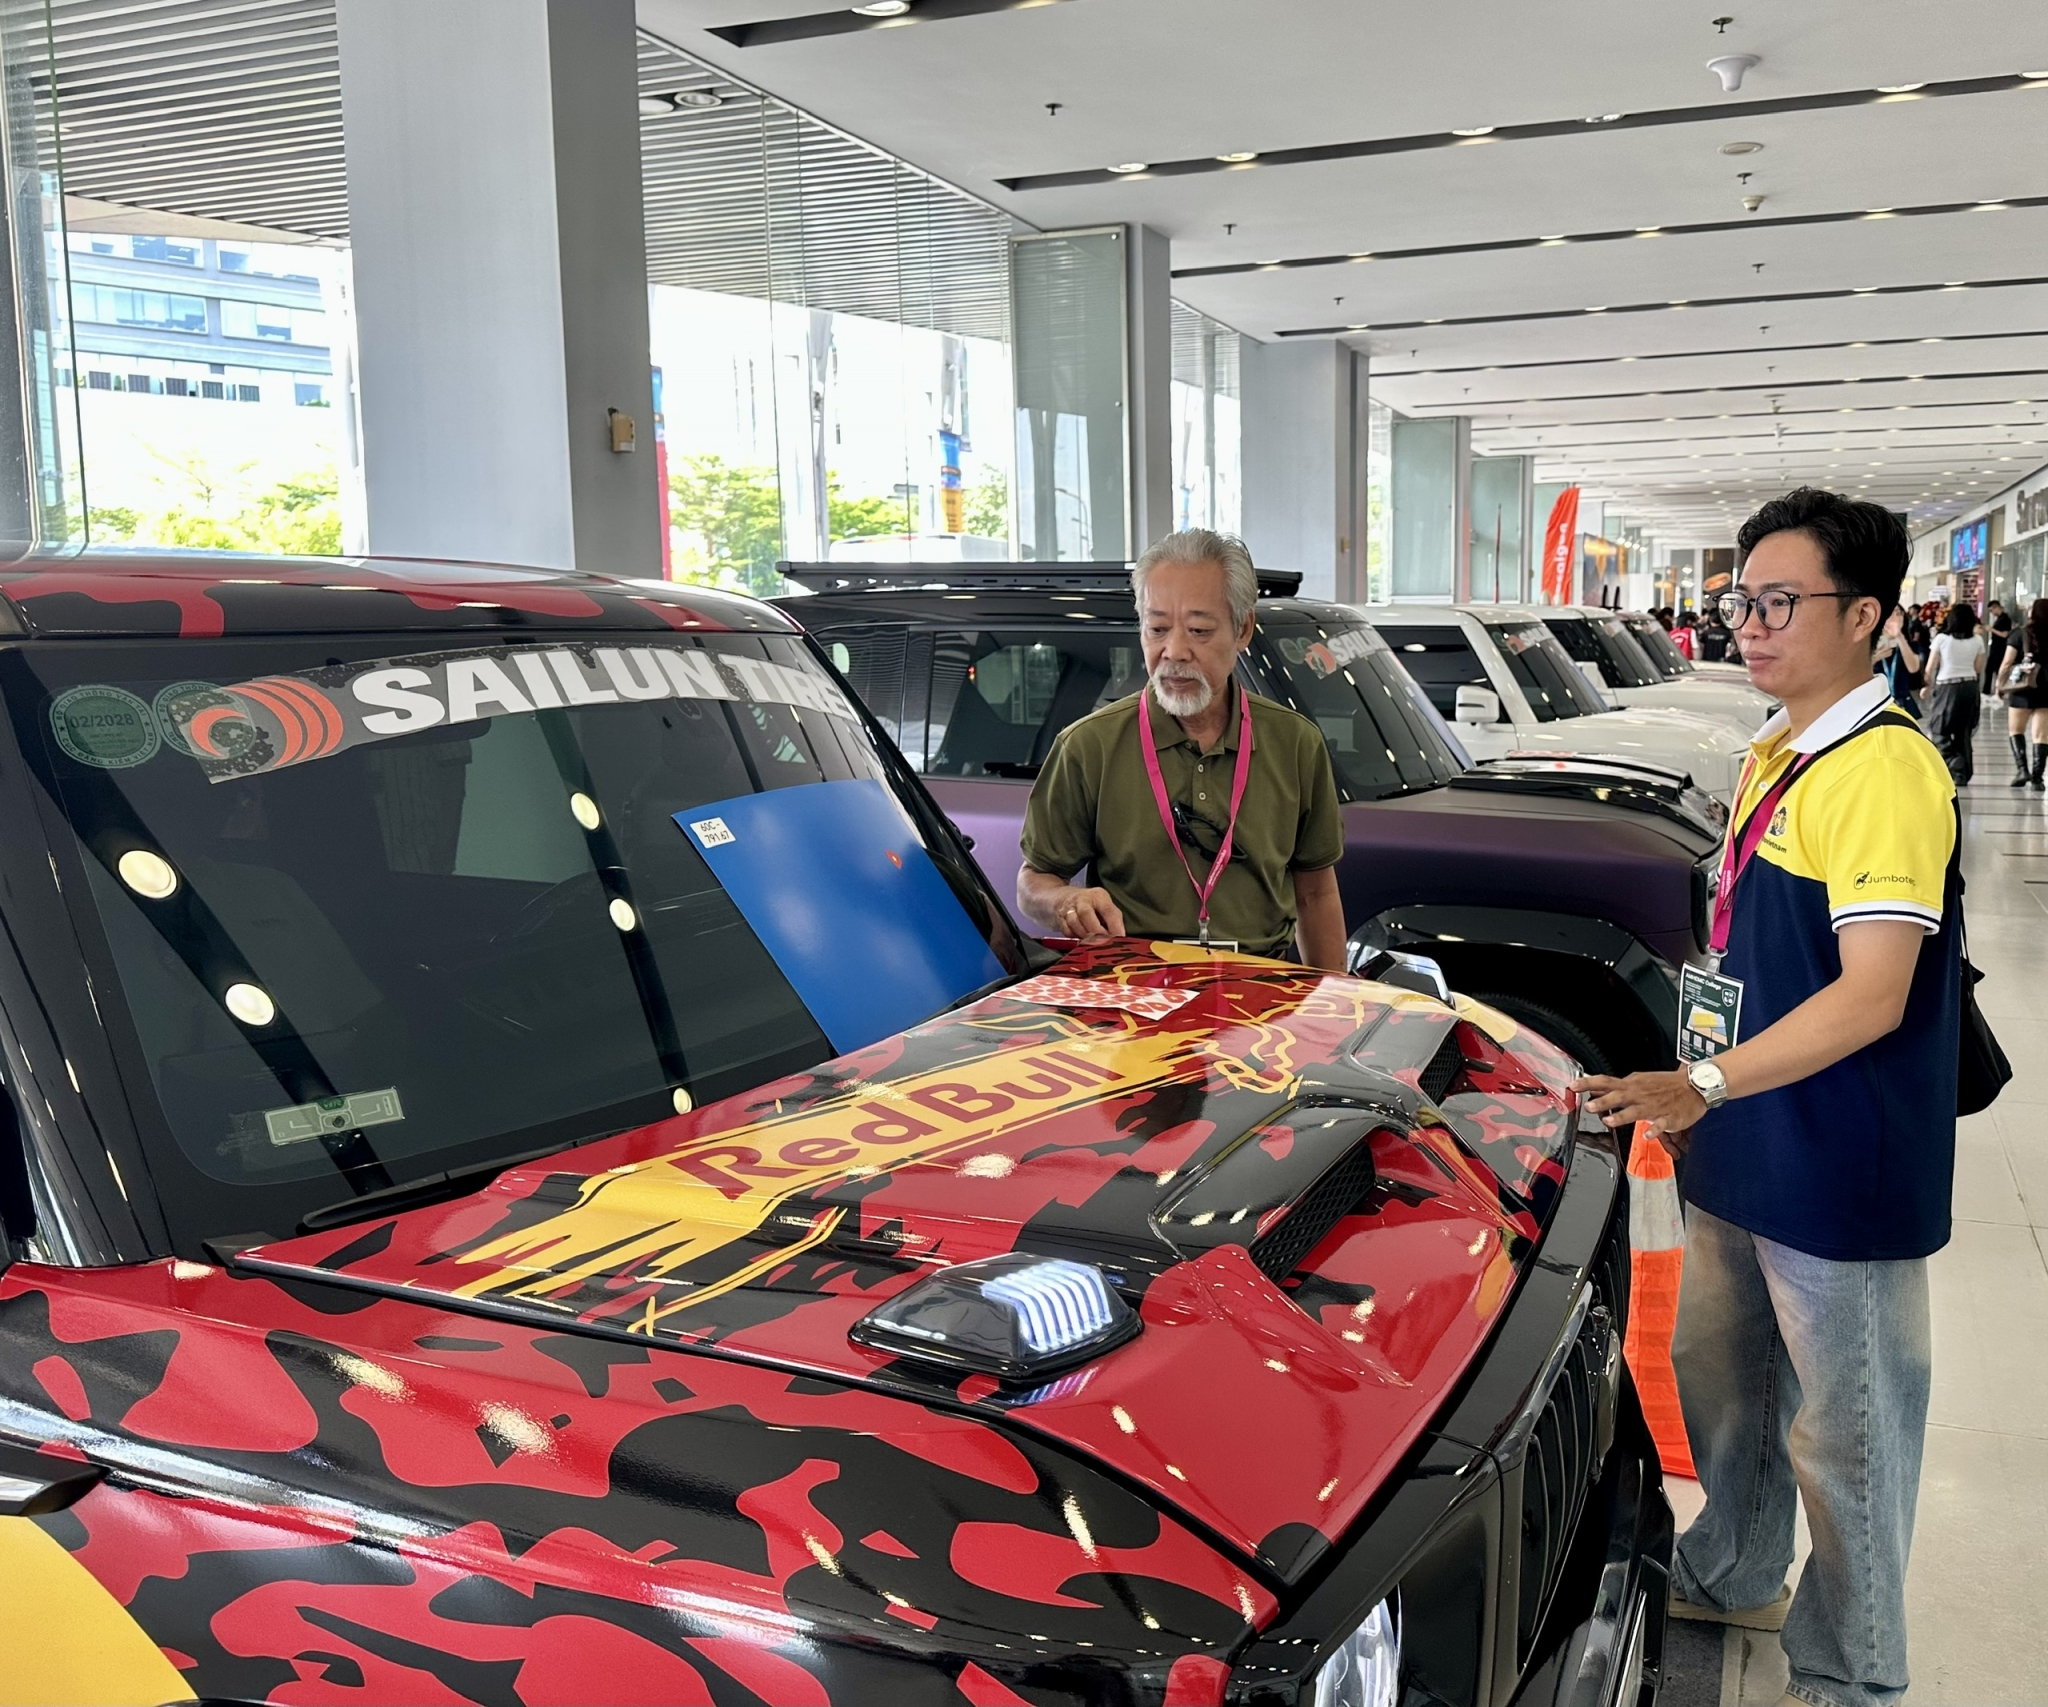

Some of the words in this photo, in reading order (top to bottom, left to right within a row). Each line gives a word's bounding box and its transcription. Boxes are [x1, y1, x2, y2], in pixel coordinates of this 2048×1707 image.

[69, 713, 135, 729] 02/2028
[352, 648, 729, 735] SAILUN
[667, 1102, 942, 1200] Red
[909, 1050, 1126, 1124] Bull
